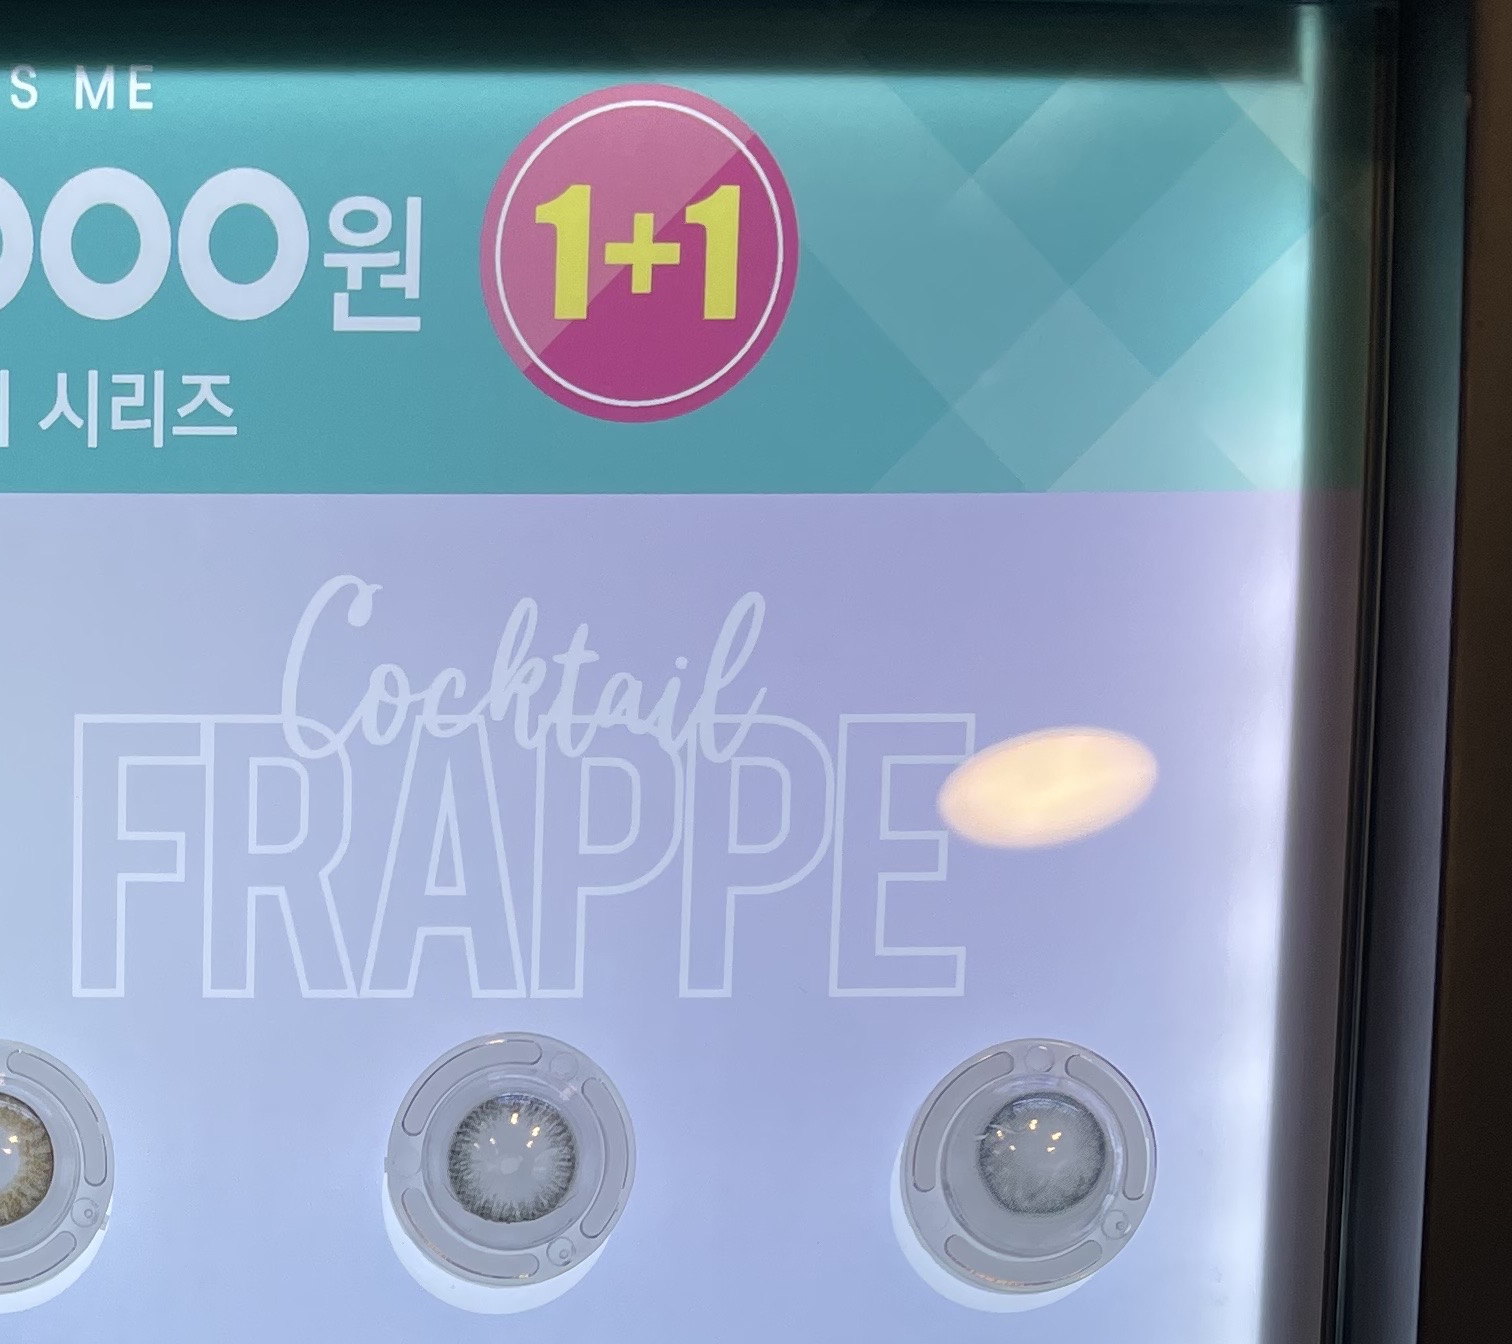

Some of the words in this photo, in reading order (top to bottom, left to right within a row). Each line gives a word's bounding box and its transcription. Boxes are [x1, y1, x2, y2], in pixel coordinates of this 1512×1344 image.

[75, 64, 153, 110] ME
[536, 183, 741, 323] 1+1
[38, 367, 238, 450] 시리즈
[281, 574, 768, 763] Cocktail
[72, 714, 976, 997] FRAPPE
